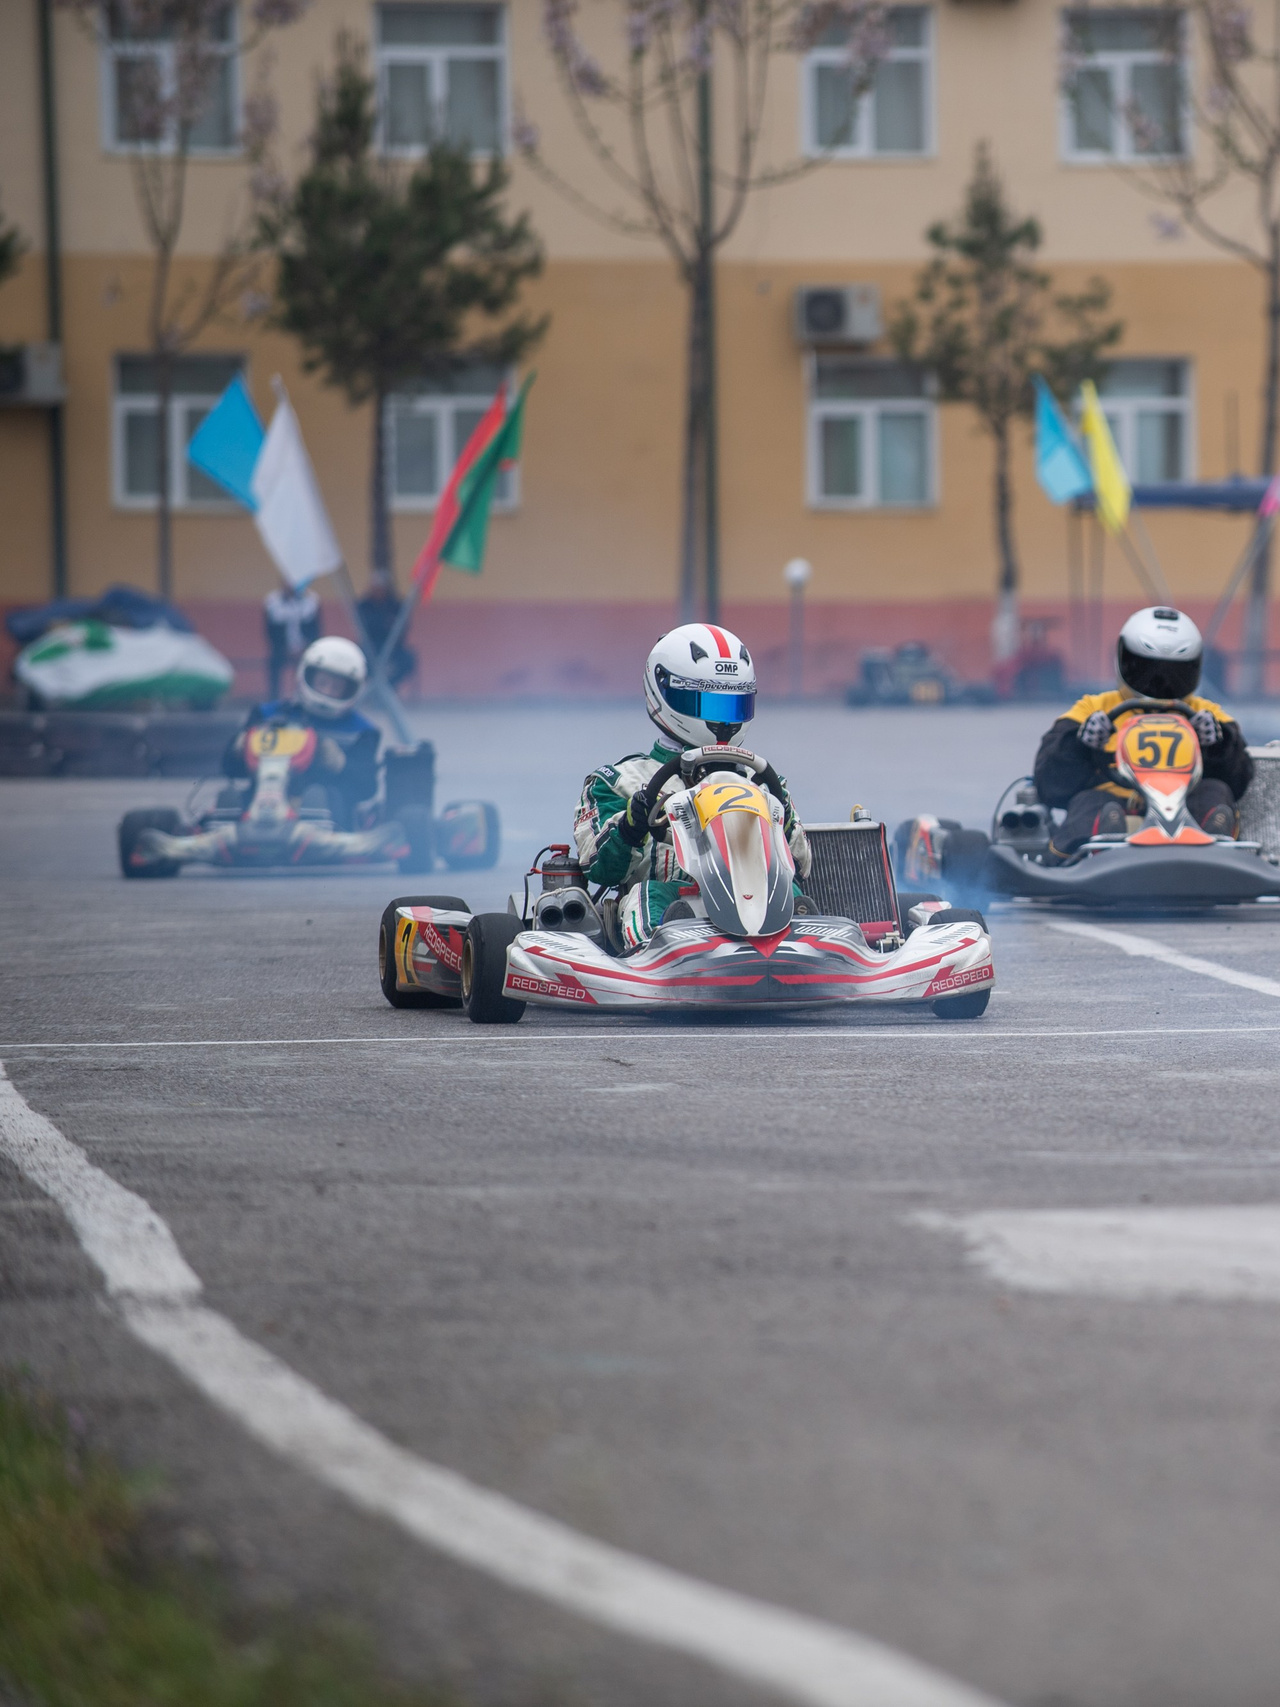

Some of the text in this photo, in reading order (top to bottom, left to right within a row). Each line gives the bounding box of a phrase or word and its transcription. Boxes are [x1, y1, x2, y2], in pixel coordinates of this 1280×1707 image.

[715, 663, 738, 673] OMP
[1138, 730, 1183, 769] 57
[713, 784, 759, 812] 2
[511, 976, 586, 1000] REDSPEED
[931, 967, 990, 992] REDSPEED
